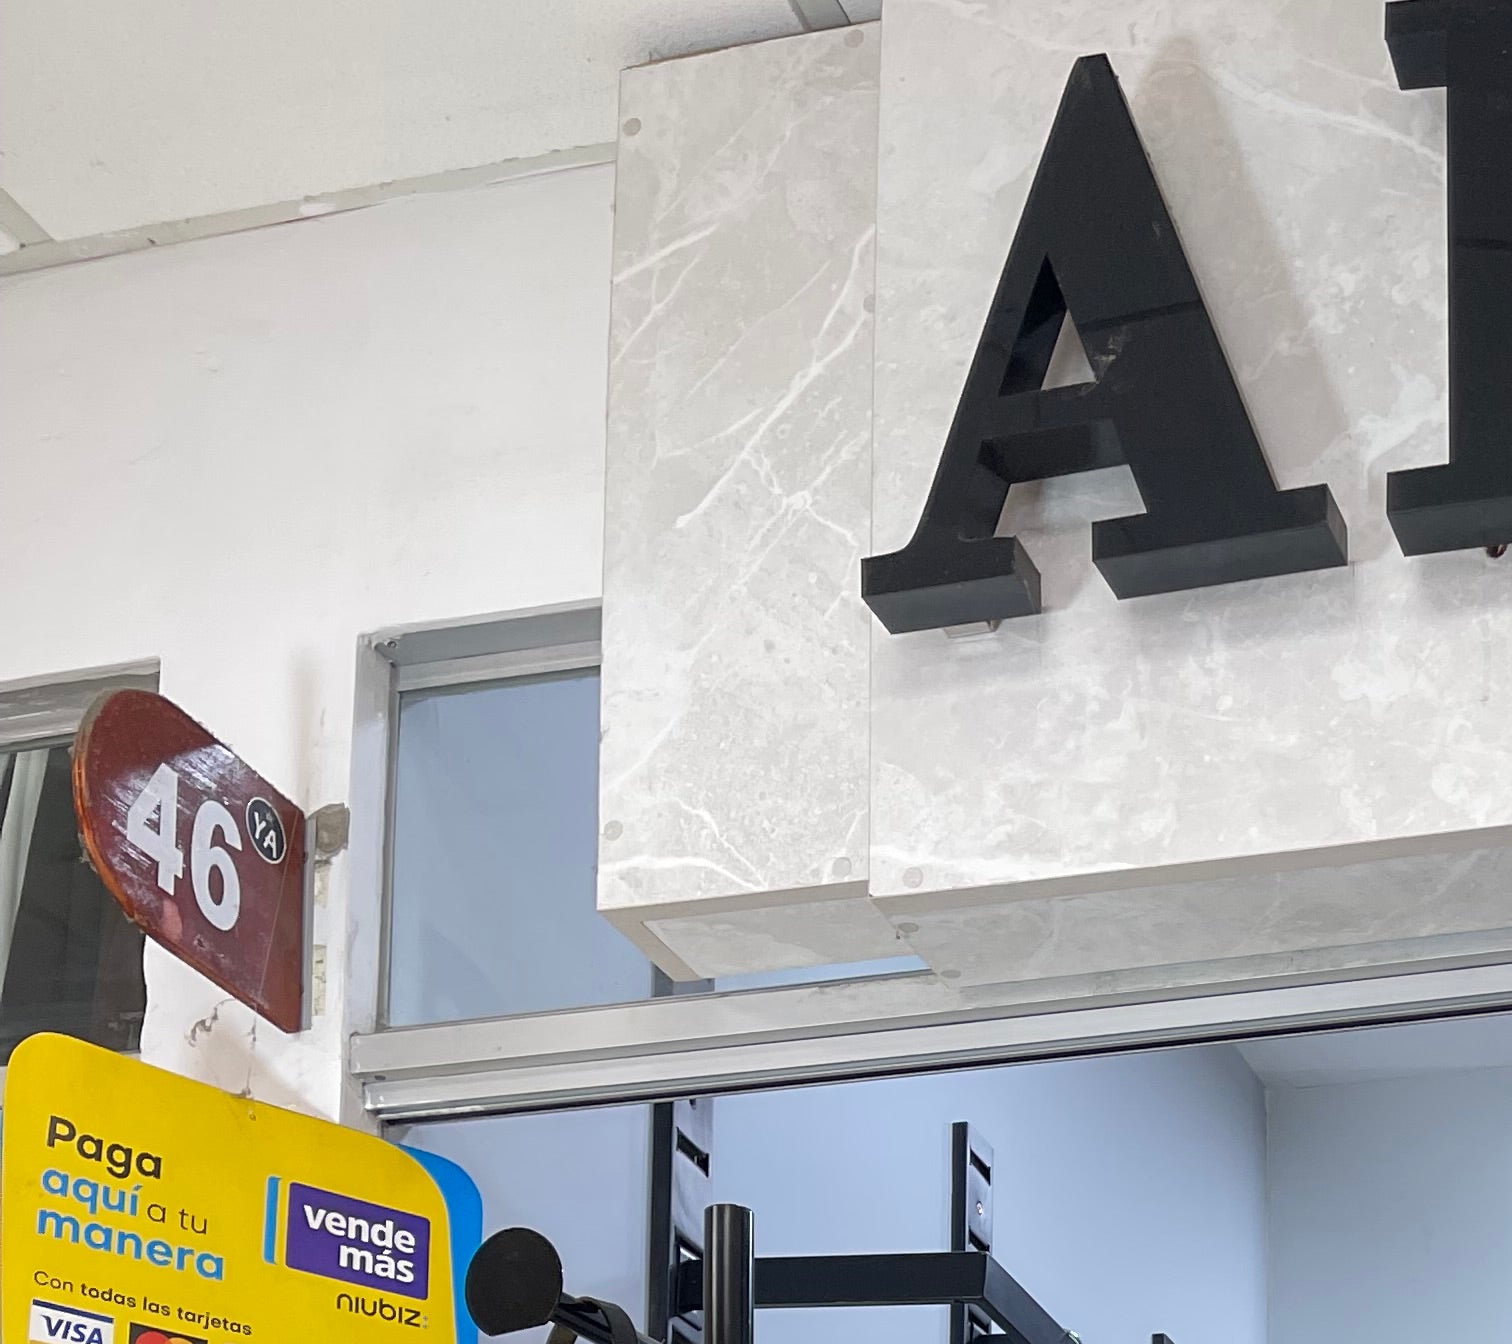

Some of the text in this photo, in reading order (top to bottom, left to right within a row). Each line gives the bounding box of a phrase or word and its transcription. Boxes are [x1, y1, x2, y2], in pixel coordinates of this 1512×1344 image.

[125, 761, 243, 932] 46
[251, 811, 282, 858] YA
[46, 1115, 163, 1180] Paga
[42, 1168, 208, 1235] aquí a tu
[303, 1204, 416, 1254] vende
[37, 1208, 225, 1281] manera
[339, 1244, 415, 1283] más
[34, 1270, 252, 1336] Con todas las tarjetas
